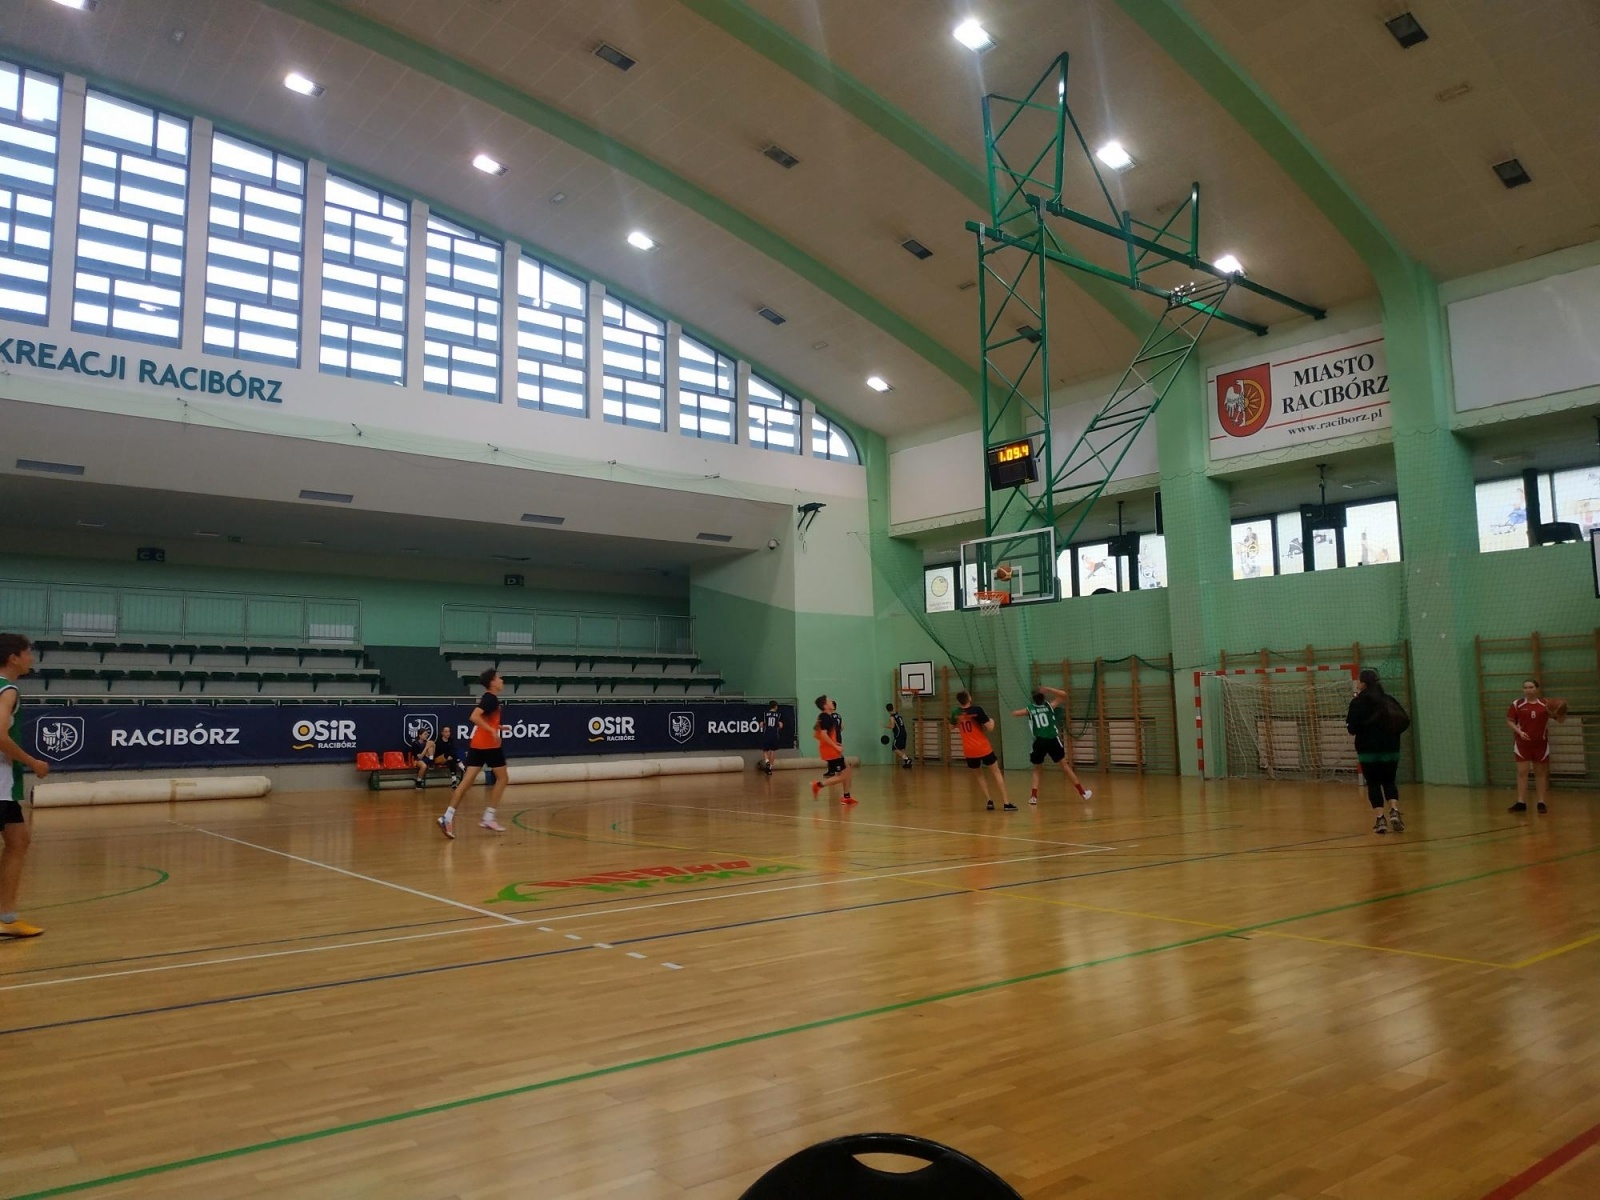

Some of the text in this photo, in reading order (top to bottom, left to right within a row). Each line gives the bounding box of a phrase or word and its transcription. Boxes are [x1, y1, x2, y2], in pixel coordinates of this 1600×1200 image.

[1293, 353, 1374, 387] MIASTO
[139, 359, 283, 403] RACIBÓRZ
[1282, 375, 1390, 414] RACIBÓRZ
[1288, 409, 1383, 436] www.raciborz.pl
[292, 720, 357, 741] OSiR
[588, 716, 635, 735] OSiR
[768, 717, 776, 727] 10
[959, 720, 972, 733] 10
[1033, 712, 1050, 729] 10
[111, 723, 240, 747] RACIBÓRZ
[318, 741, 357, 749] RACIBÓRZ
